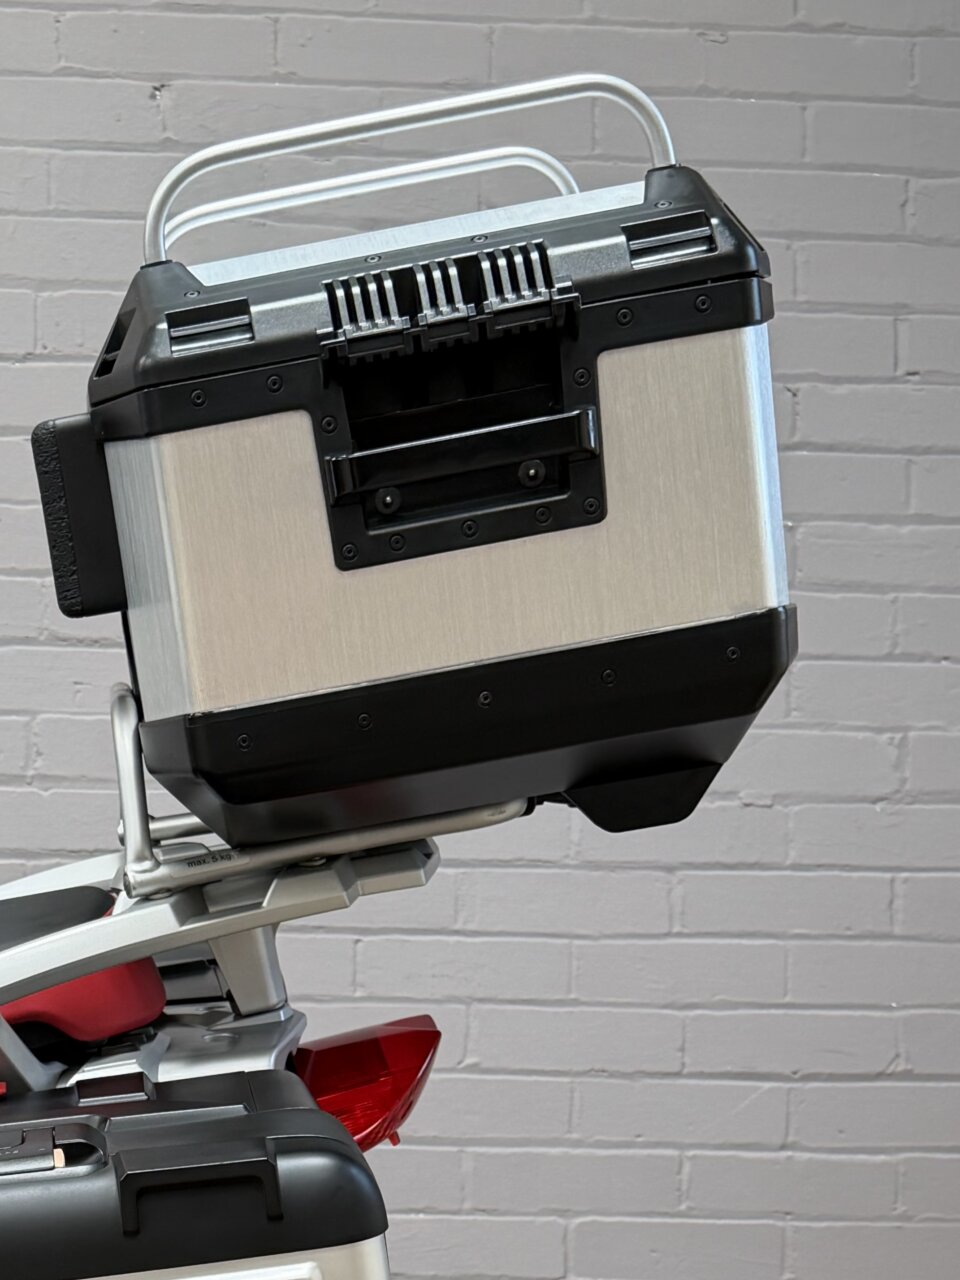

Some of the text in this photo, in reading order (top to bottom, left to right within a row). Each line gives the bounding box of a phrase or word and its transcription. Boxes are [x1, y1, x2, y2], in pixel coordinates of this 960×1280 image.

[187, 853, 232, 868] max. 5 kg
